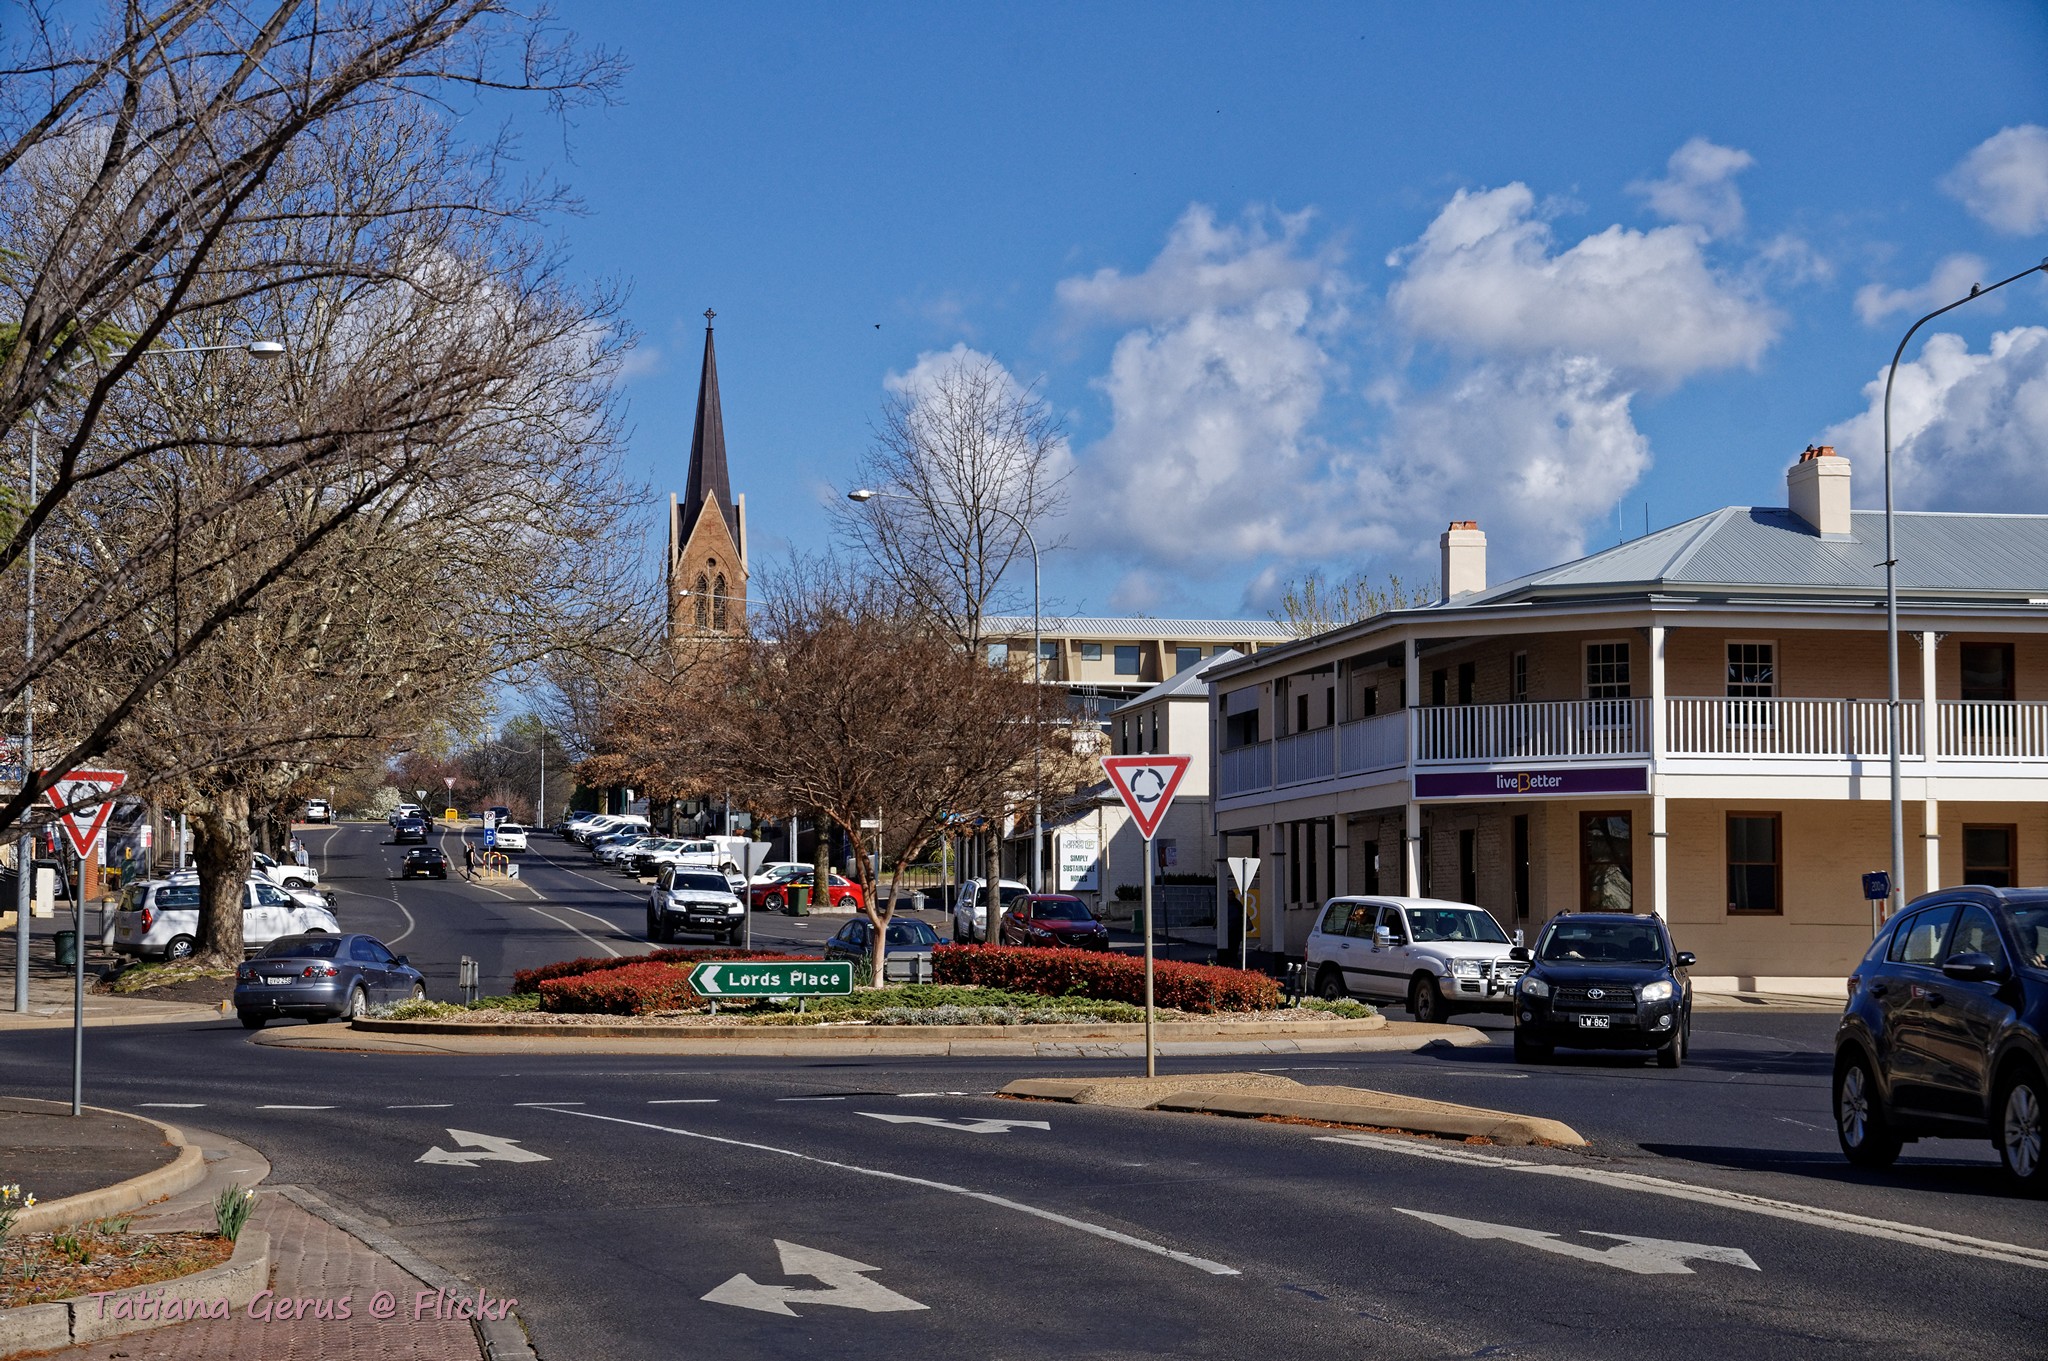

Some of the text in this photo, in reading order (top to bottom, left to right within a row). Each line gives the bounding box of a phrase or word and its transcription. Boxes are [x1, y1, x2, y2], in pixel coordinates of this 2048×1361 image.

[1496, 773, 1563, 793] liveBetter
[1070, 854, 1089, 862] SIMPLY
[1062, 864, 1096, 873] SUSTAINABLE
[1070, 875, 1088, 883] HOMES
[729, 970, 841, 987] Lords Place
